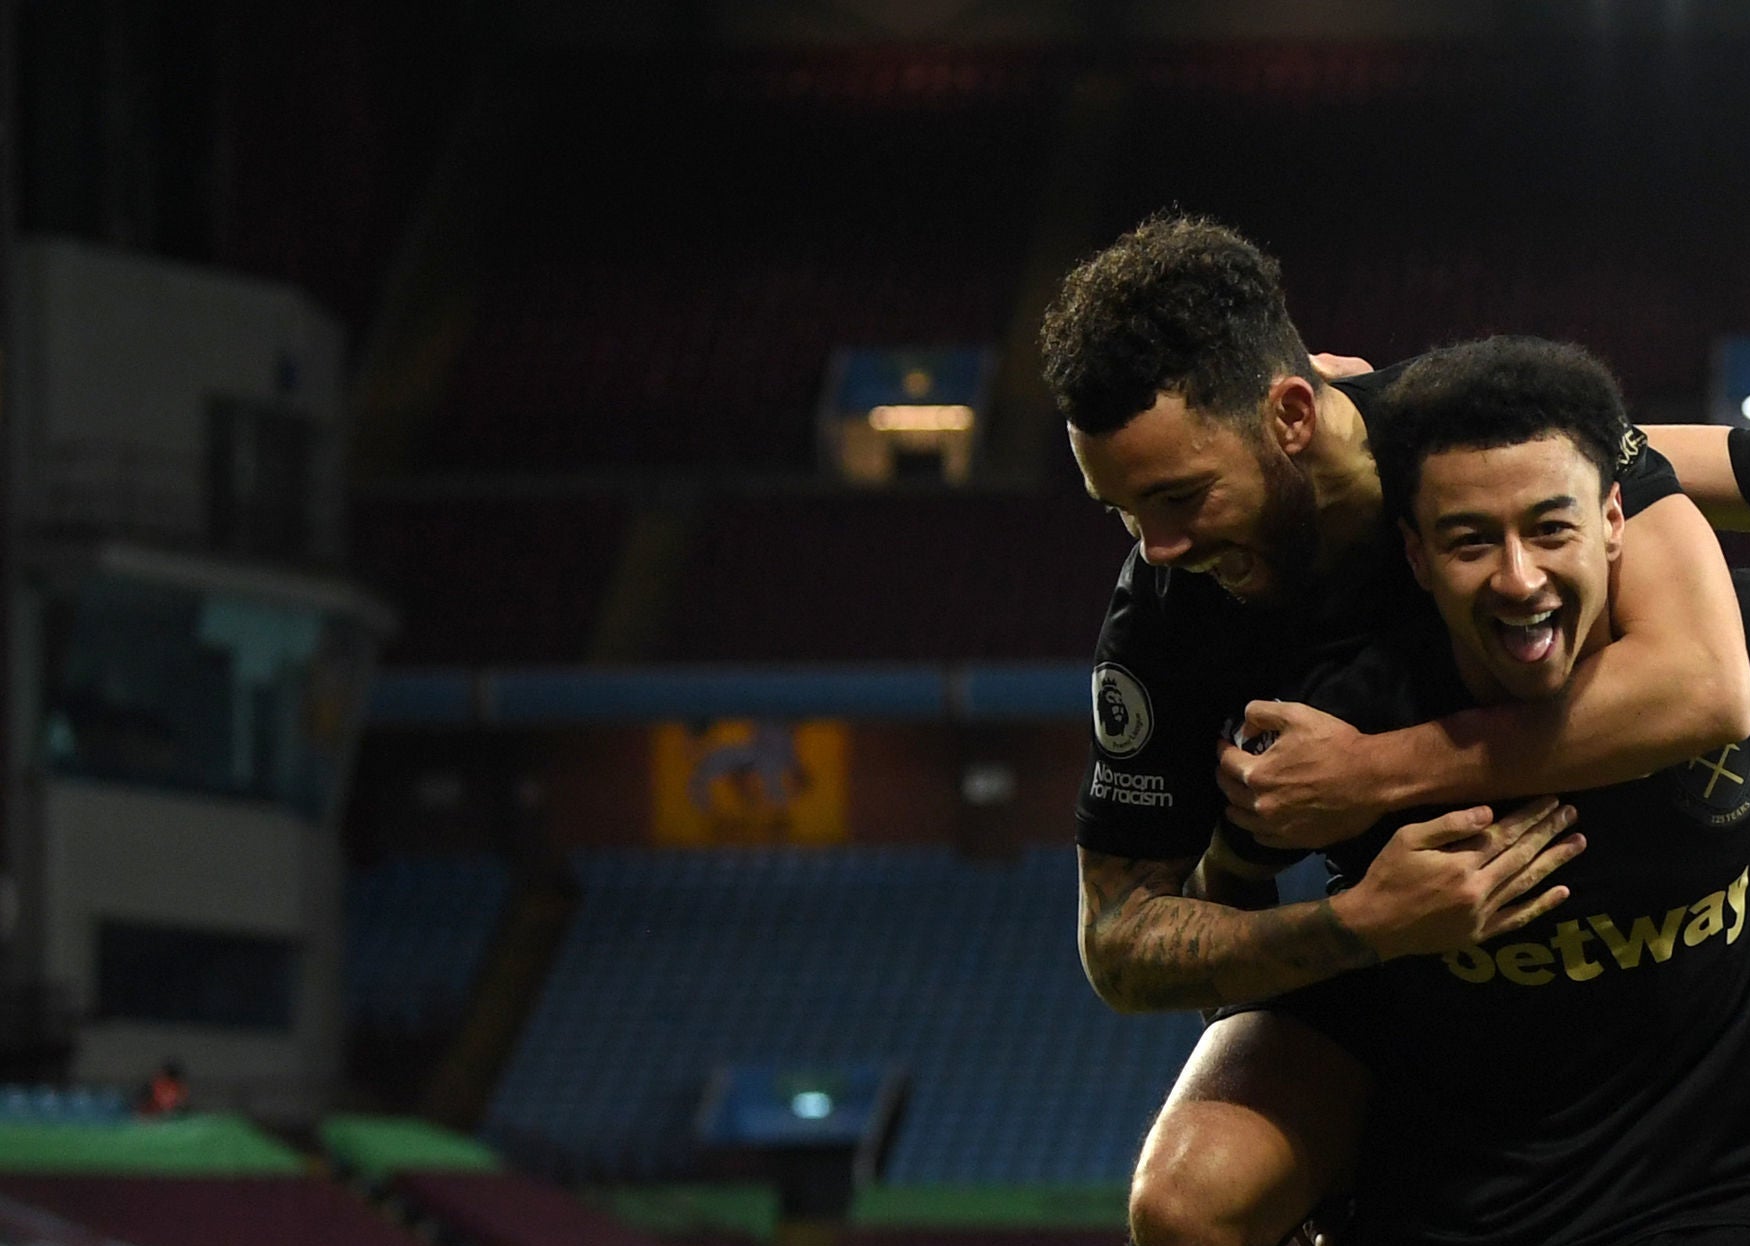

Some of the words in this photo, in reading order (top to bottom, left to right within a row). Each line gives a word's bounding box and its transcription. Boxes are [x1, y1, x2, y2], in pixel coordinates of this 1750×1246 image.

[1092, 760, 1114, 783] No
[1113, 771, 1165, 791] room
[1111, 788, 1175, 807] racism
